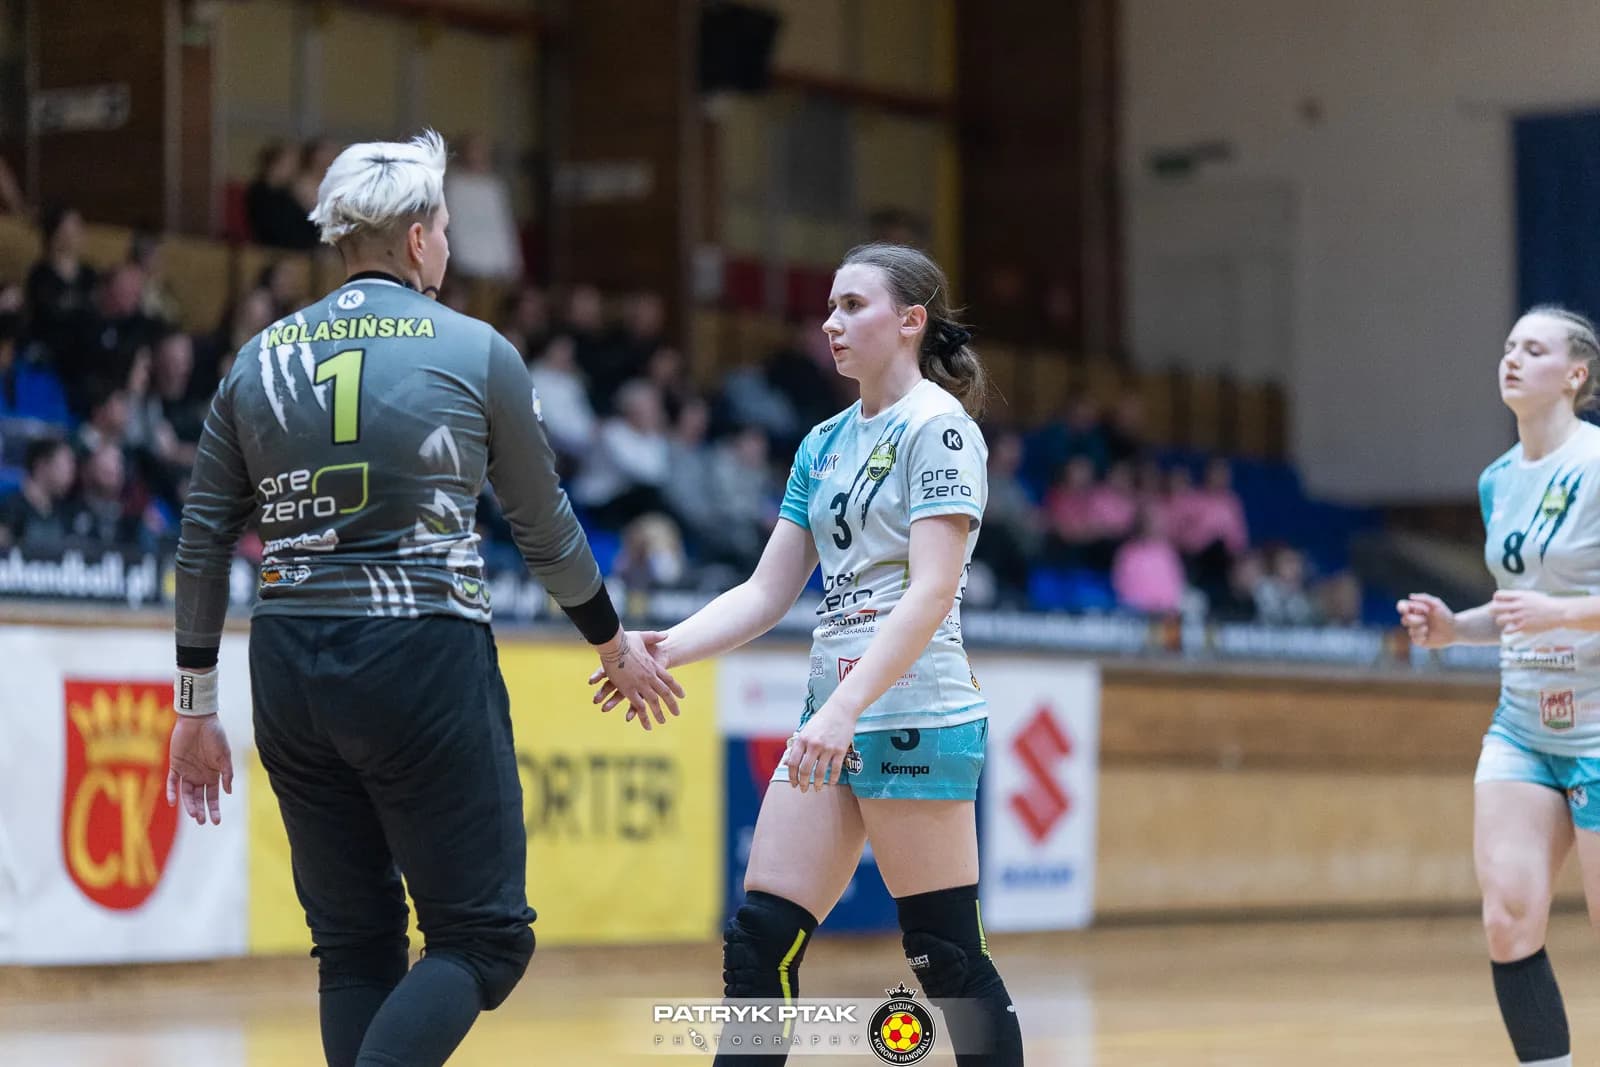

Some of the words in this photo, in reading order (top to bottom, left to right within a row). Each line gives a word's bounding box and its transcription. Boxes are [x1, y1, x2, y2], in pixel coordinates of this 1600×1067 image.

[266, 313, 436, 348] KOLASIŃSKA
[314, 348, 366, 445] 1
[257, 469, 311, 501] pre
[921, 468, 959, 487] pre
[923, 484, 972, 500] zero
[261, 496, 336, 523] zero
[829, 492, 853, 550] 3
[1503, 531, 1526, 574] 8
[181, 676, 192, 709] Kempa
[881, 762, 930, 778] Kempa
